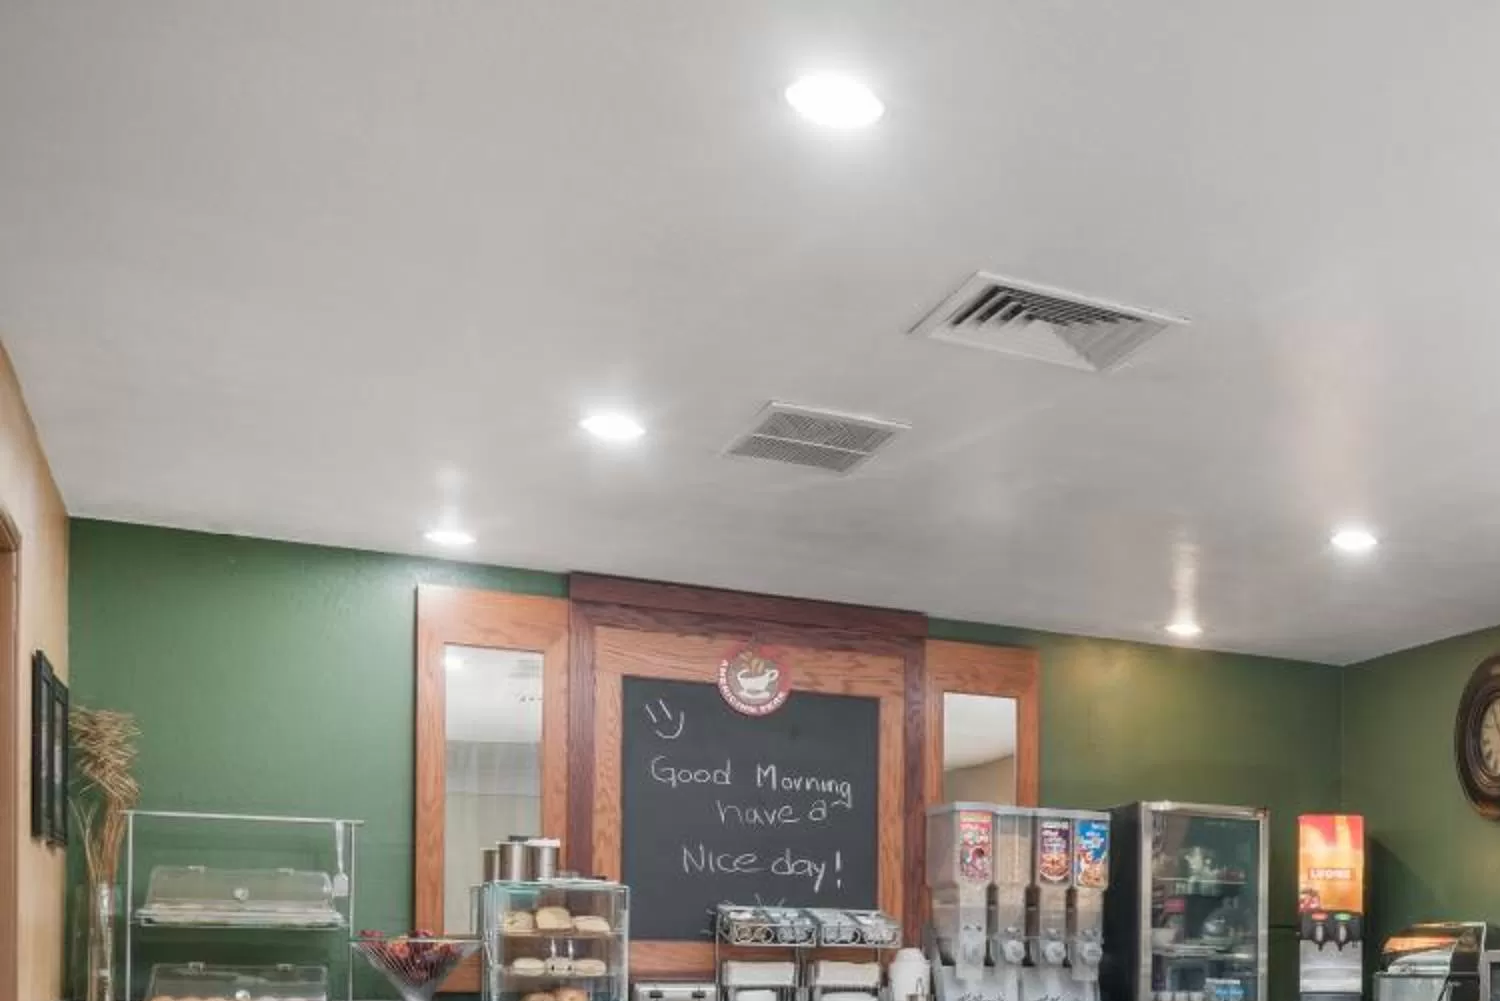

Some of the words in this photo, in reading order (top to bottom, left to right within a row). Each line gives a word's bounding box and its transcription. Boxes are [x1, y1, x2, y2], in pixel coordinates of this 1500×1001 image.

[651, 755, 731, 788] Good
[756, 763, 852, 808] Morning
[716, 800, 800, 825] have
[808, 799, 827, 821] a
[682, 845, 764, 873] Nice
